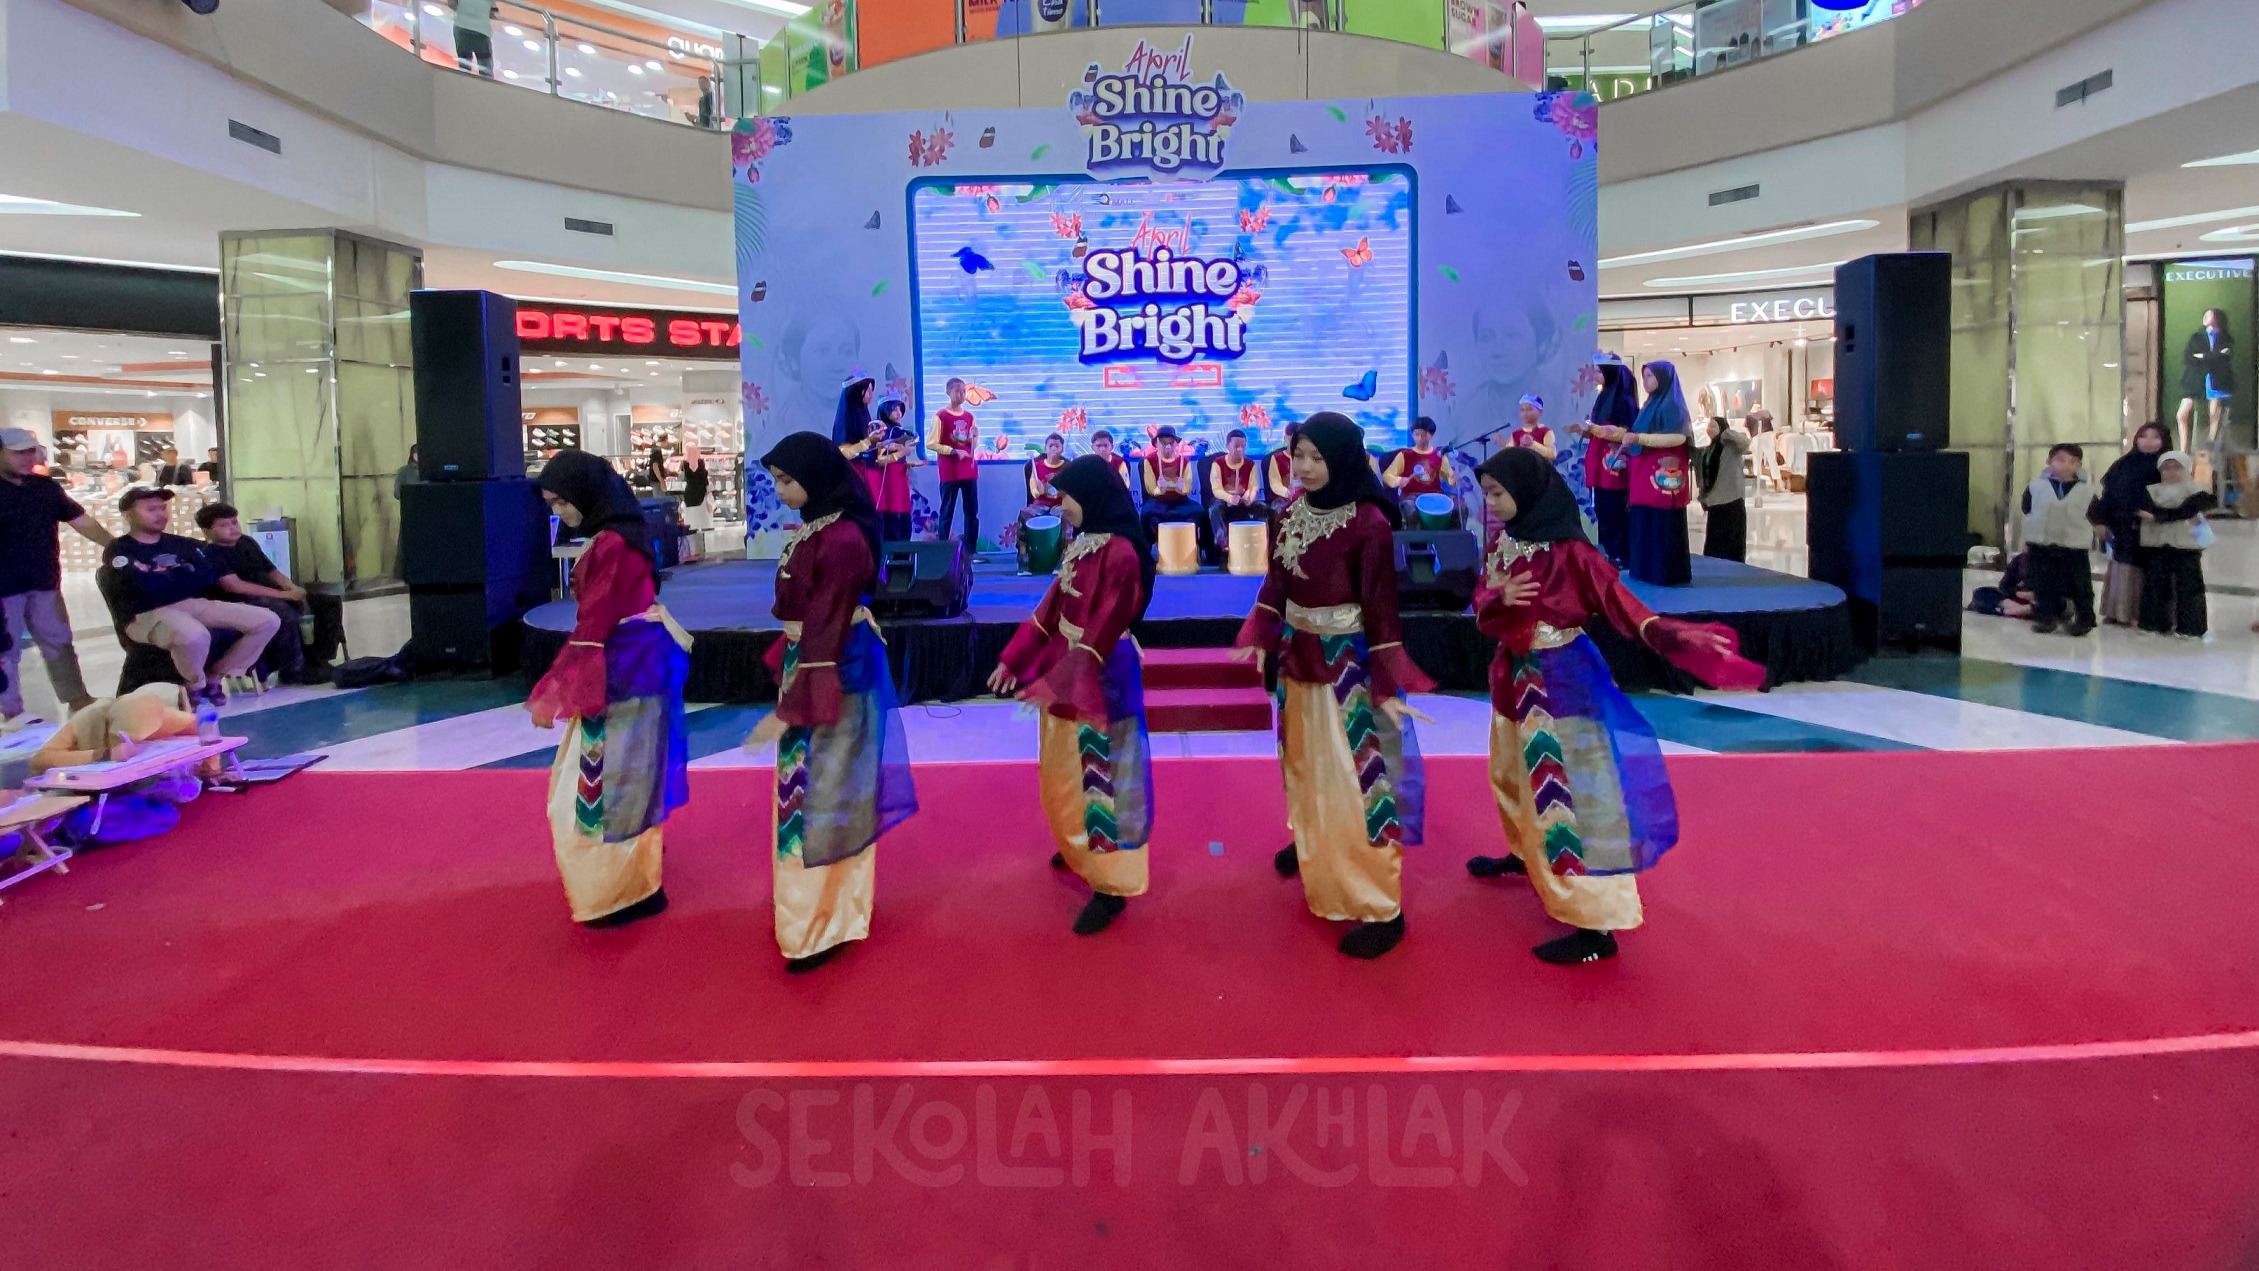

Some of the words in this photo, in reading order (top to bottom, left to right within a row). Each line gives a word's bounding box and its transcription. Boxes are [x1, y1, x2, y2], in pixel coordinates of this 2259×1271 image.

[1125, 35, 1191, 86] April
[1095, 77, 1218, 116] Shine
[1091, 122, 1226, 168] Bright
[1130, 213, 1192, 262] April
[1086, 249, 1238, 299] Shine
[2165, 269, 2254, 281] EXECUTIVE
[515, 310, 655, 344] ORTS
[1082, 303, 1243, 360] Bright
[69, 416, 135, 426] CONVERSE
